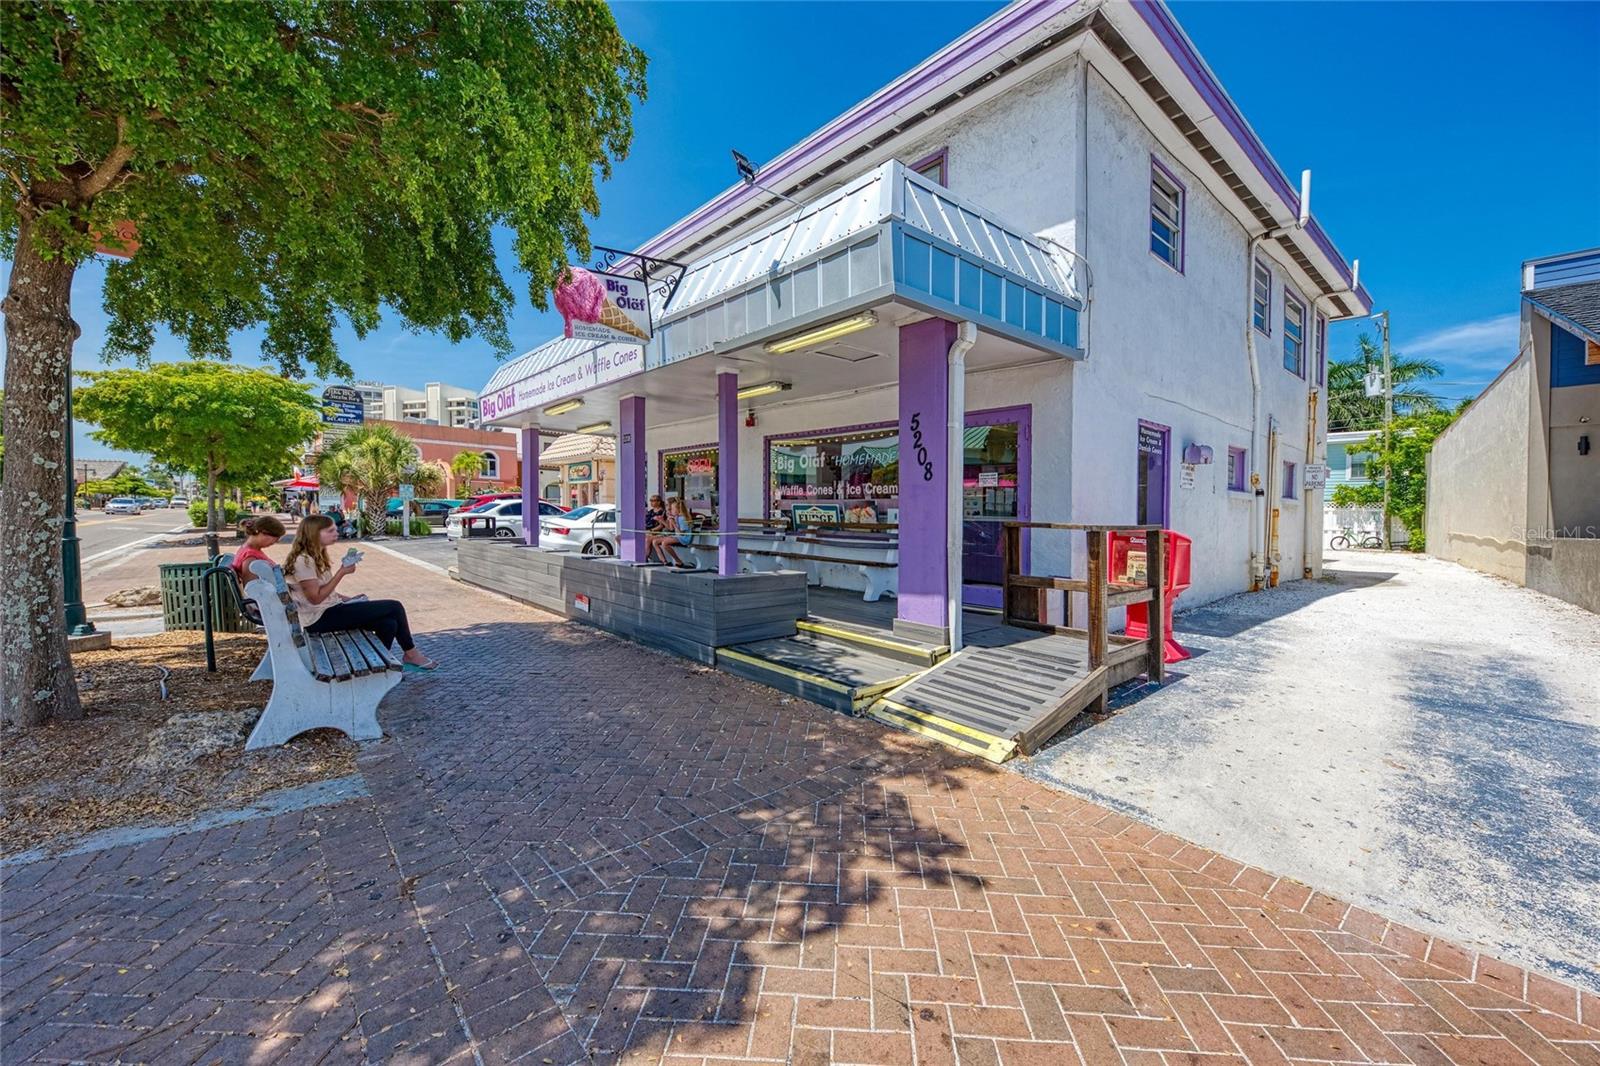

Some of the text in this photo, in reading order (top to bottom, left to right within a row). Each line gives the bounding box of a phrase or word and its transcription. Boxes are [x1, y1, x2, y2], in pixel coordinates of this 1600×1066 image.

[606, 279, 628, 296] Big
[616, 296, 646, 311] Oläf
[574, 324, 611, 334] HOMEMADE
[482, 399, 496, 418] Big
[518, 383, 546, 401] Homemade
[546, 381, 555, 392] Ice
[555, 374, 577, 388] Cream
[577, 366, 583, 380] &
[585, 359, 611, 377] Waffle
[612, 348, 638, 368] Cones
[910, 412, 933, 481] 5208
[777, 456, 794, 473] Big
[779, 482, 898, 496] Waffle Cones & Ice Cream
[798, 513, 834, 523] FUDGE
